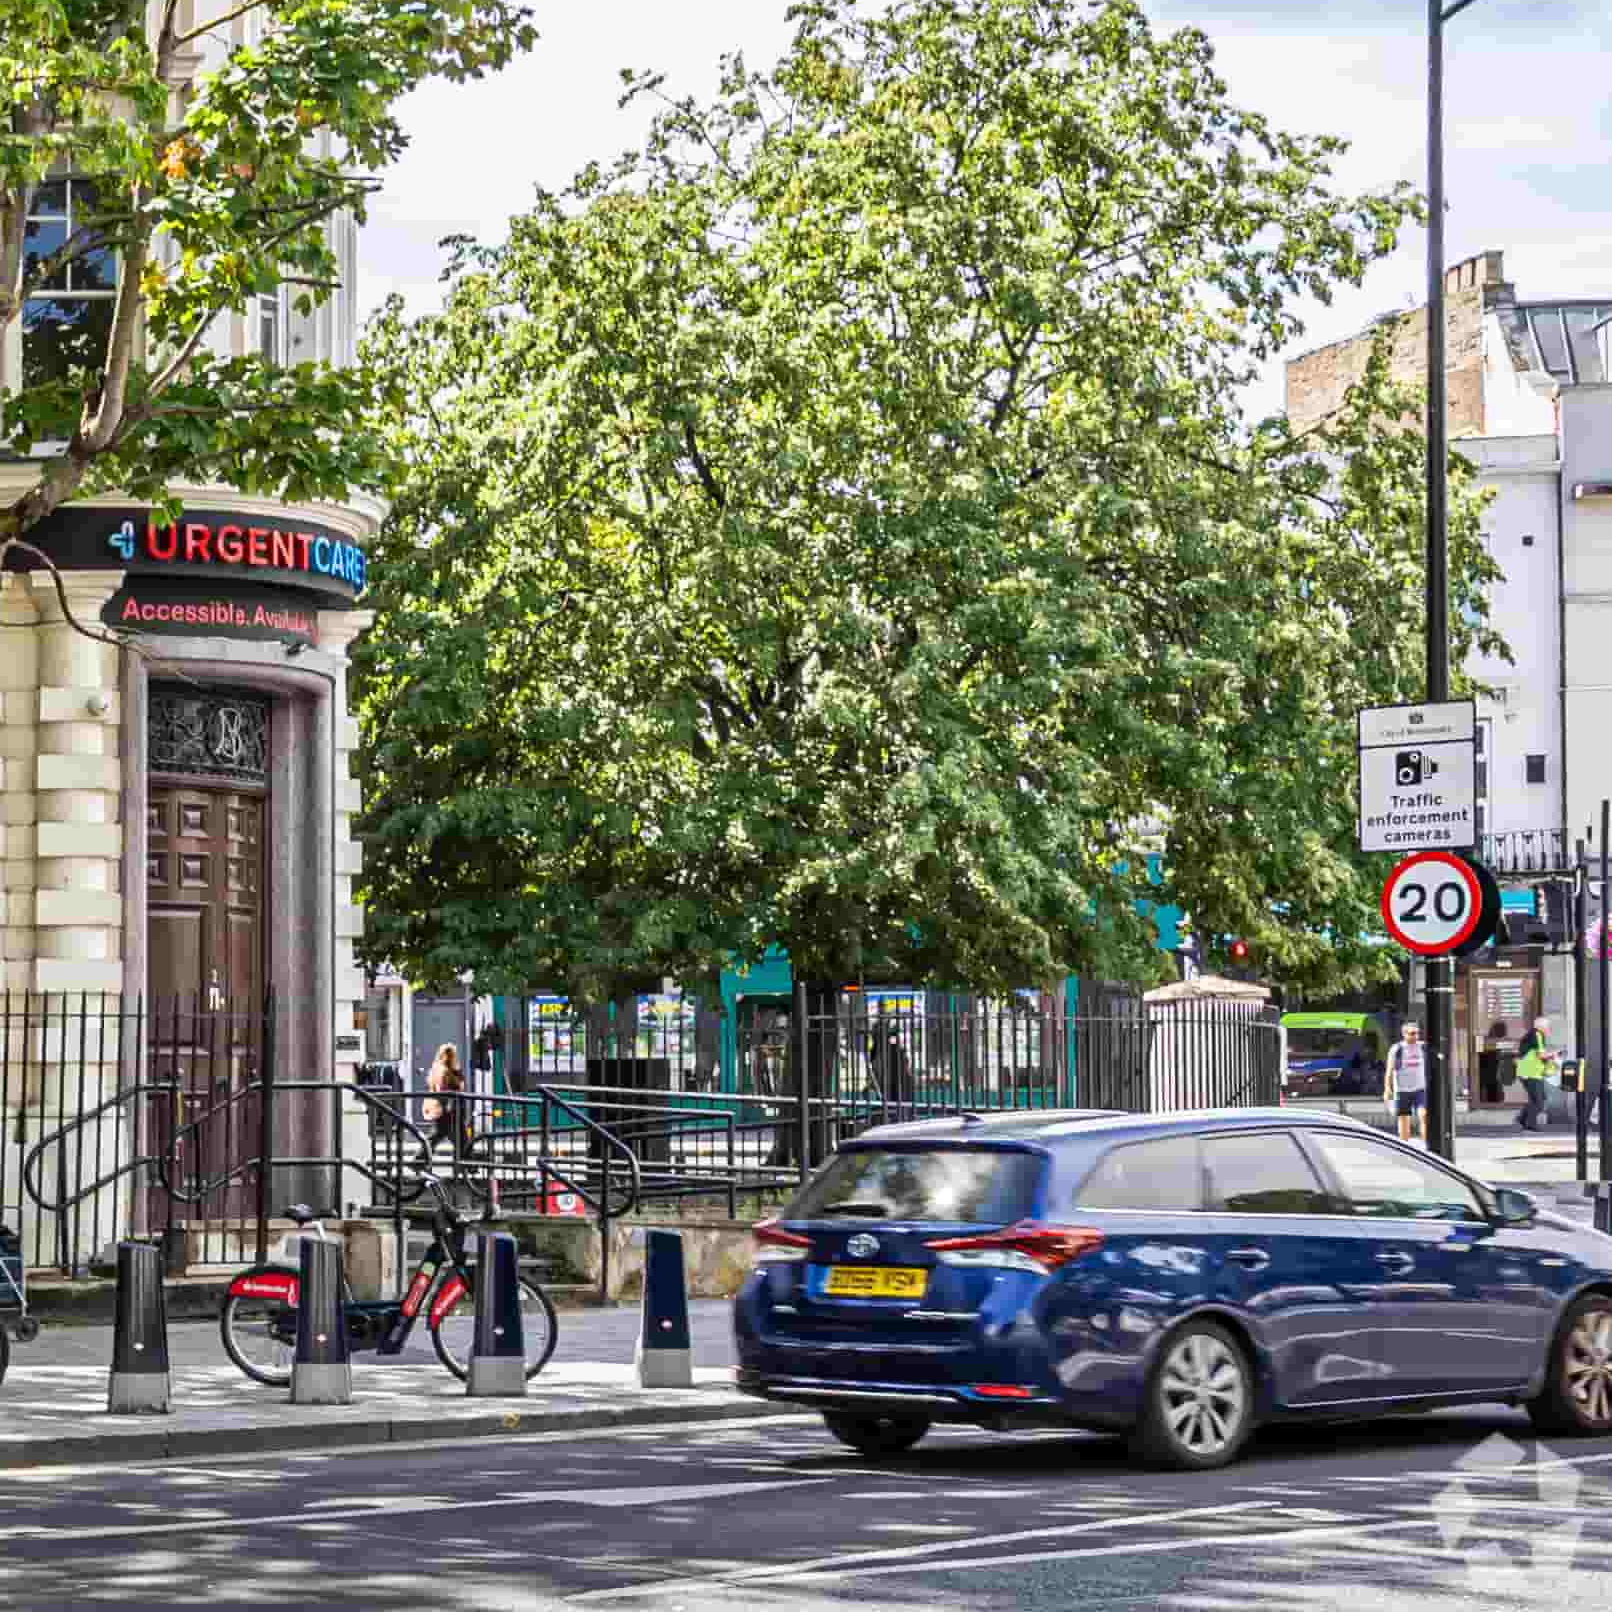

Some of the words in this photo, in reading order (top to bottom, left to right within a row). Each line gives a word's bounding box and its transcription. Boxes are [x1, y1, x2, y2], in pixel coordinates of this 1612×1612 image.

[1390, 794, 1444, 808] Traffic
[1367, 808, 1469, 828] enforcement
[1383, 829, 1452, 844] cameras
[1399, 883, 1465, 922] 20
